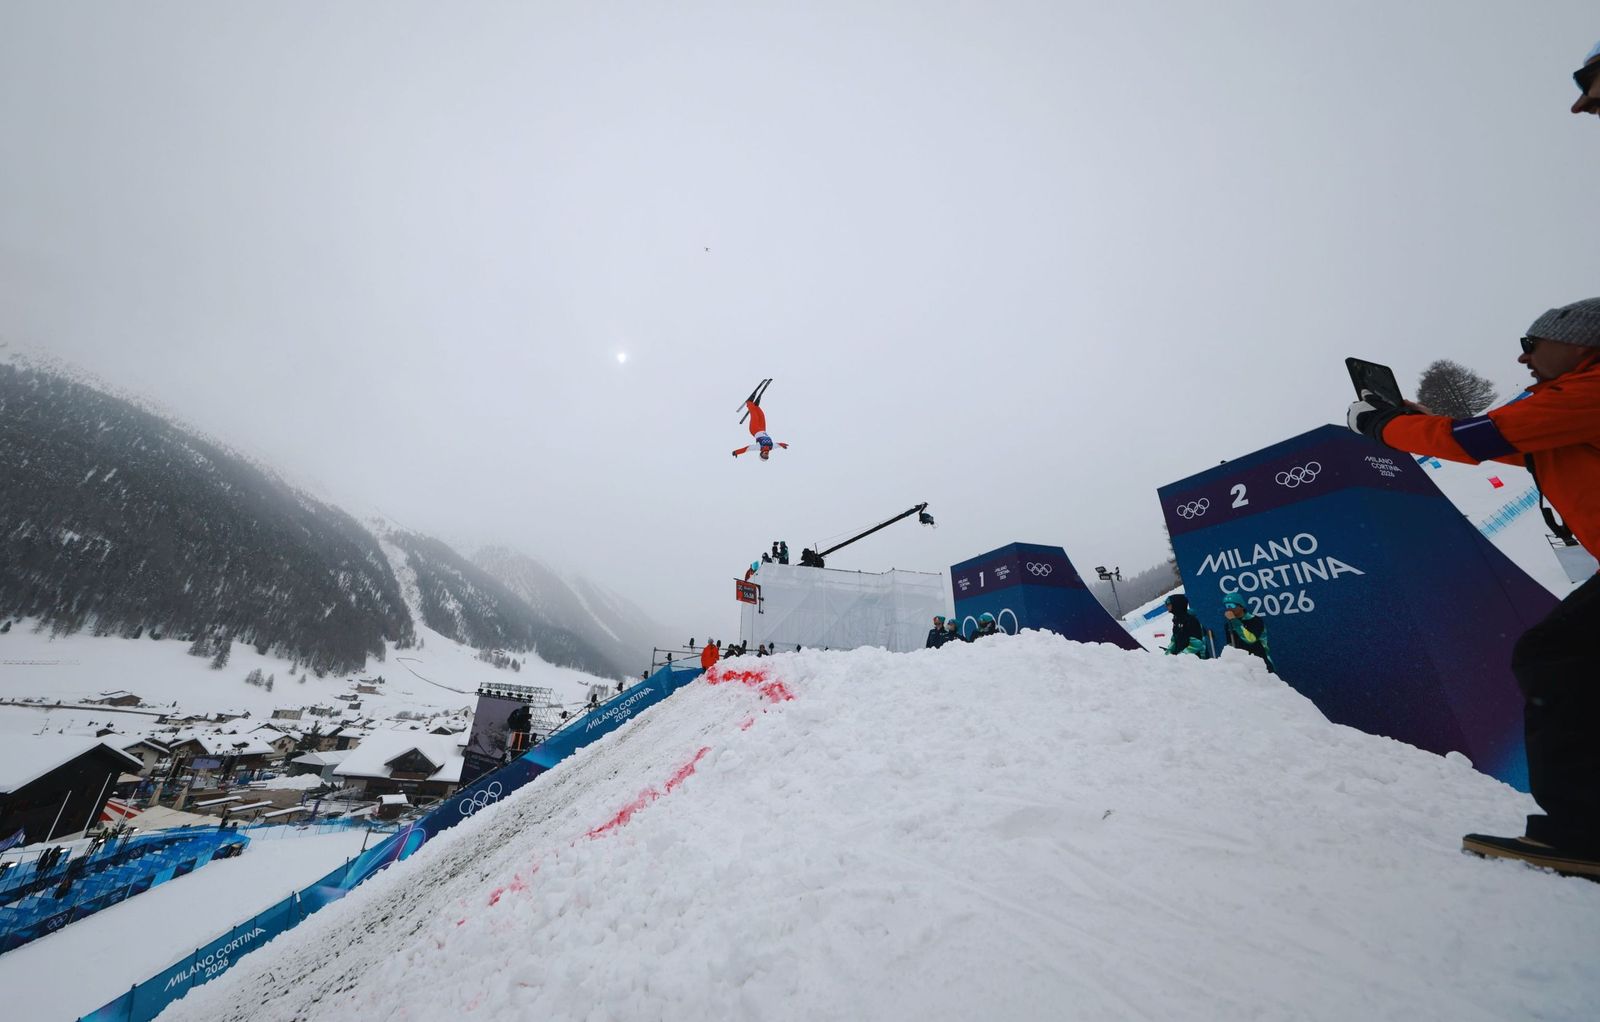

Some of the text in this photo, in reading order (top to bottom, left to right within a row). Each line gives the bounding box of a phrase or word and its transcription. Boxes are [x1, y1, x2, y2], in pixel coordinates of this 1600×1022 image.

[1230, 483, 1249, 509] 2
[1196, 533, 1318, 576] MILANO
[979, 571, 984, 587] 1
[1219, 556, 1366, 594] CORTINA
[1247, 590, 1315, 618] 2026
[586, 687, 655, 733] MILANO CORTINA
[613, 709, 632, 723] 2026
[164, 927, 266, 993] MILANO CORTINA
[204, 957, 229, 978] 2026
